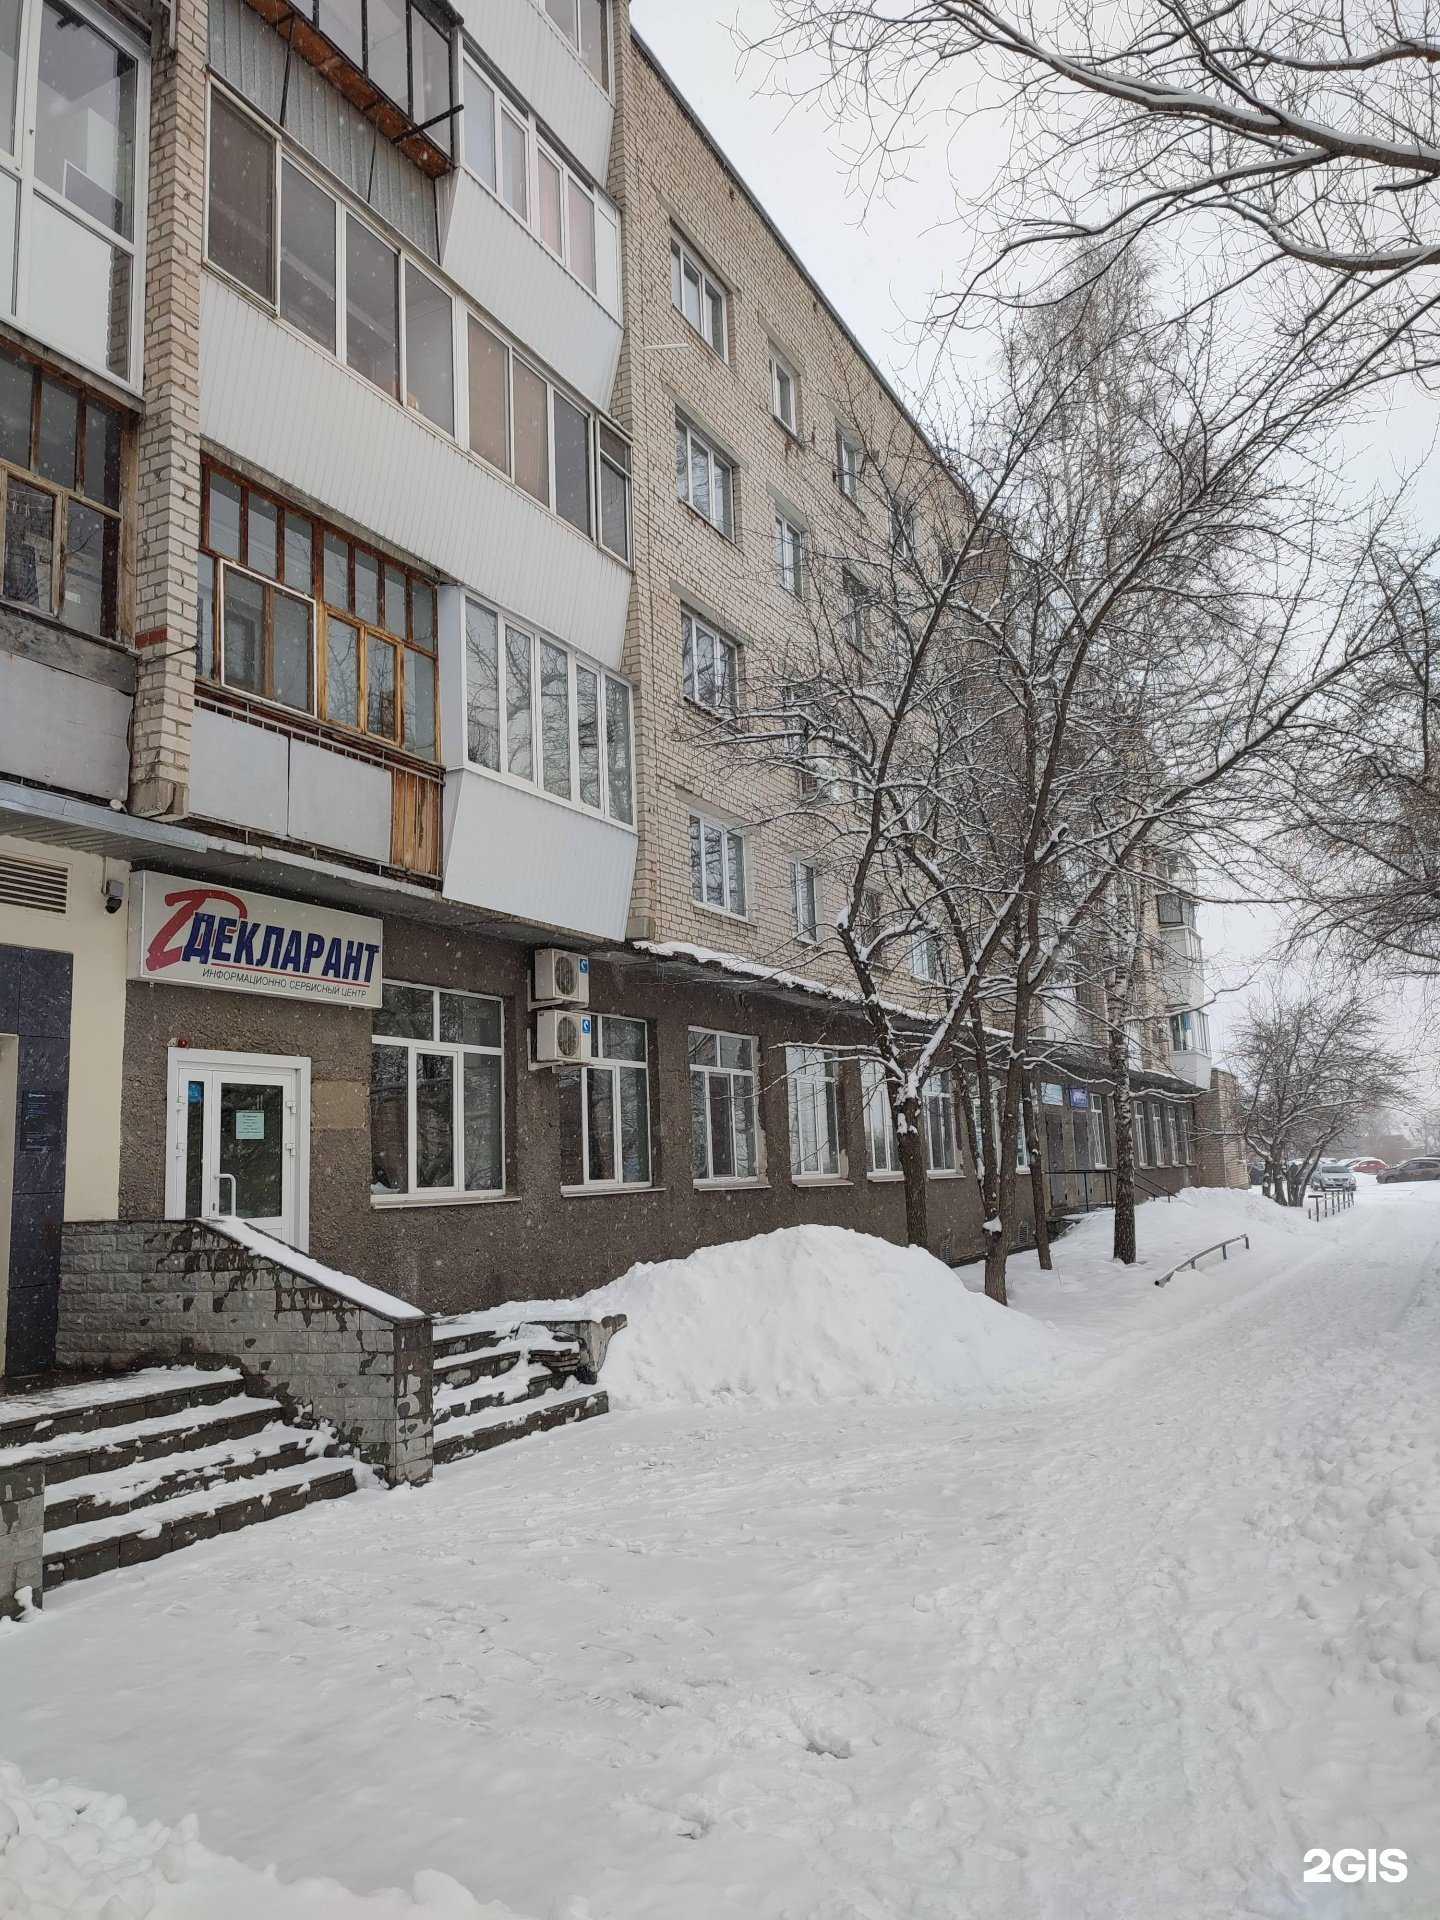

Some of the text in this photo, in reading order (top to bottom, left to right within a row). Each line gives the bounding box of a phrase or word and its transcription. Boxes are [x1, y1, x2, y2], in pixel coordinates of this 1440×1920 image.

[182, 911, 380, 983] ДЕКЛАРАНТ
[202, 967, 287, 988] ИНФОРМАЦИОННО
[341, 987, 367, 998] ЦЕНТР
